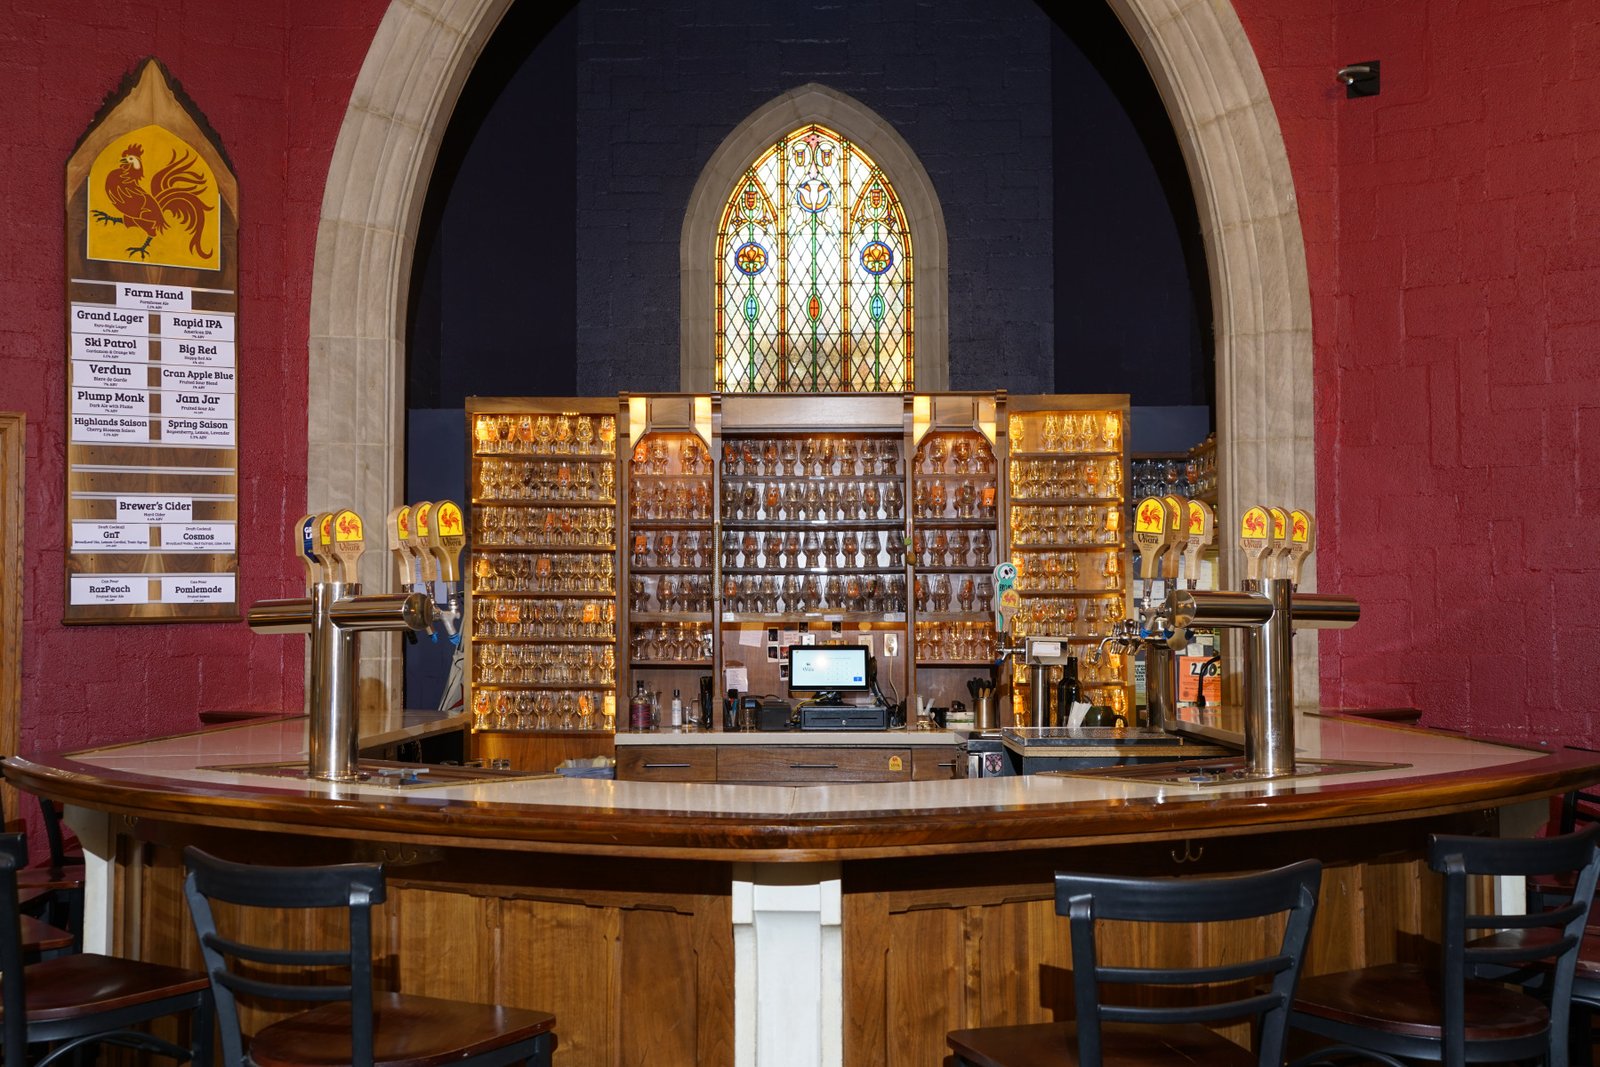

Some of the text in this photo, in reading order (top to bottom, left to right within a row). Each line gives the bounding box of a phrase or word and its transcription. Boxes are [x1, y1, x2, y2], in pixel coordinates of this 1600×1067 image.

[124, 288, 184, 301] Farm Hand
[77, 310, 144, 325] Grand Lager
[173, 317, 223, 329] Rapid IPA
[85, 337, 137, 349] Ski Patrol
[179, 344, 217, 356] Big Red
[89, 364, 131, 376] Verdun
[163, 369, 234, 381] Cran Apple Blue
[77, 391, 145, 403] Plump Monk
[175, 393, 221, 405] Jam Jar
[74, 417, 147, 427] Highlands Saison
[168, 420, 228, 430] Spring Saison
[119, 501, 192, 511] Brewer's Cider
[103, 531, 121, 539] GnT
[182, 532, 215, 541] Cosmos
[89, 585, 131, 593] RazPeach
[175, 586, 222, 594] Pomlemade
